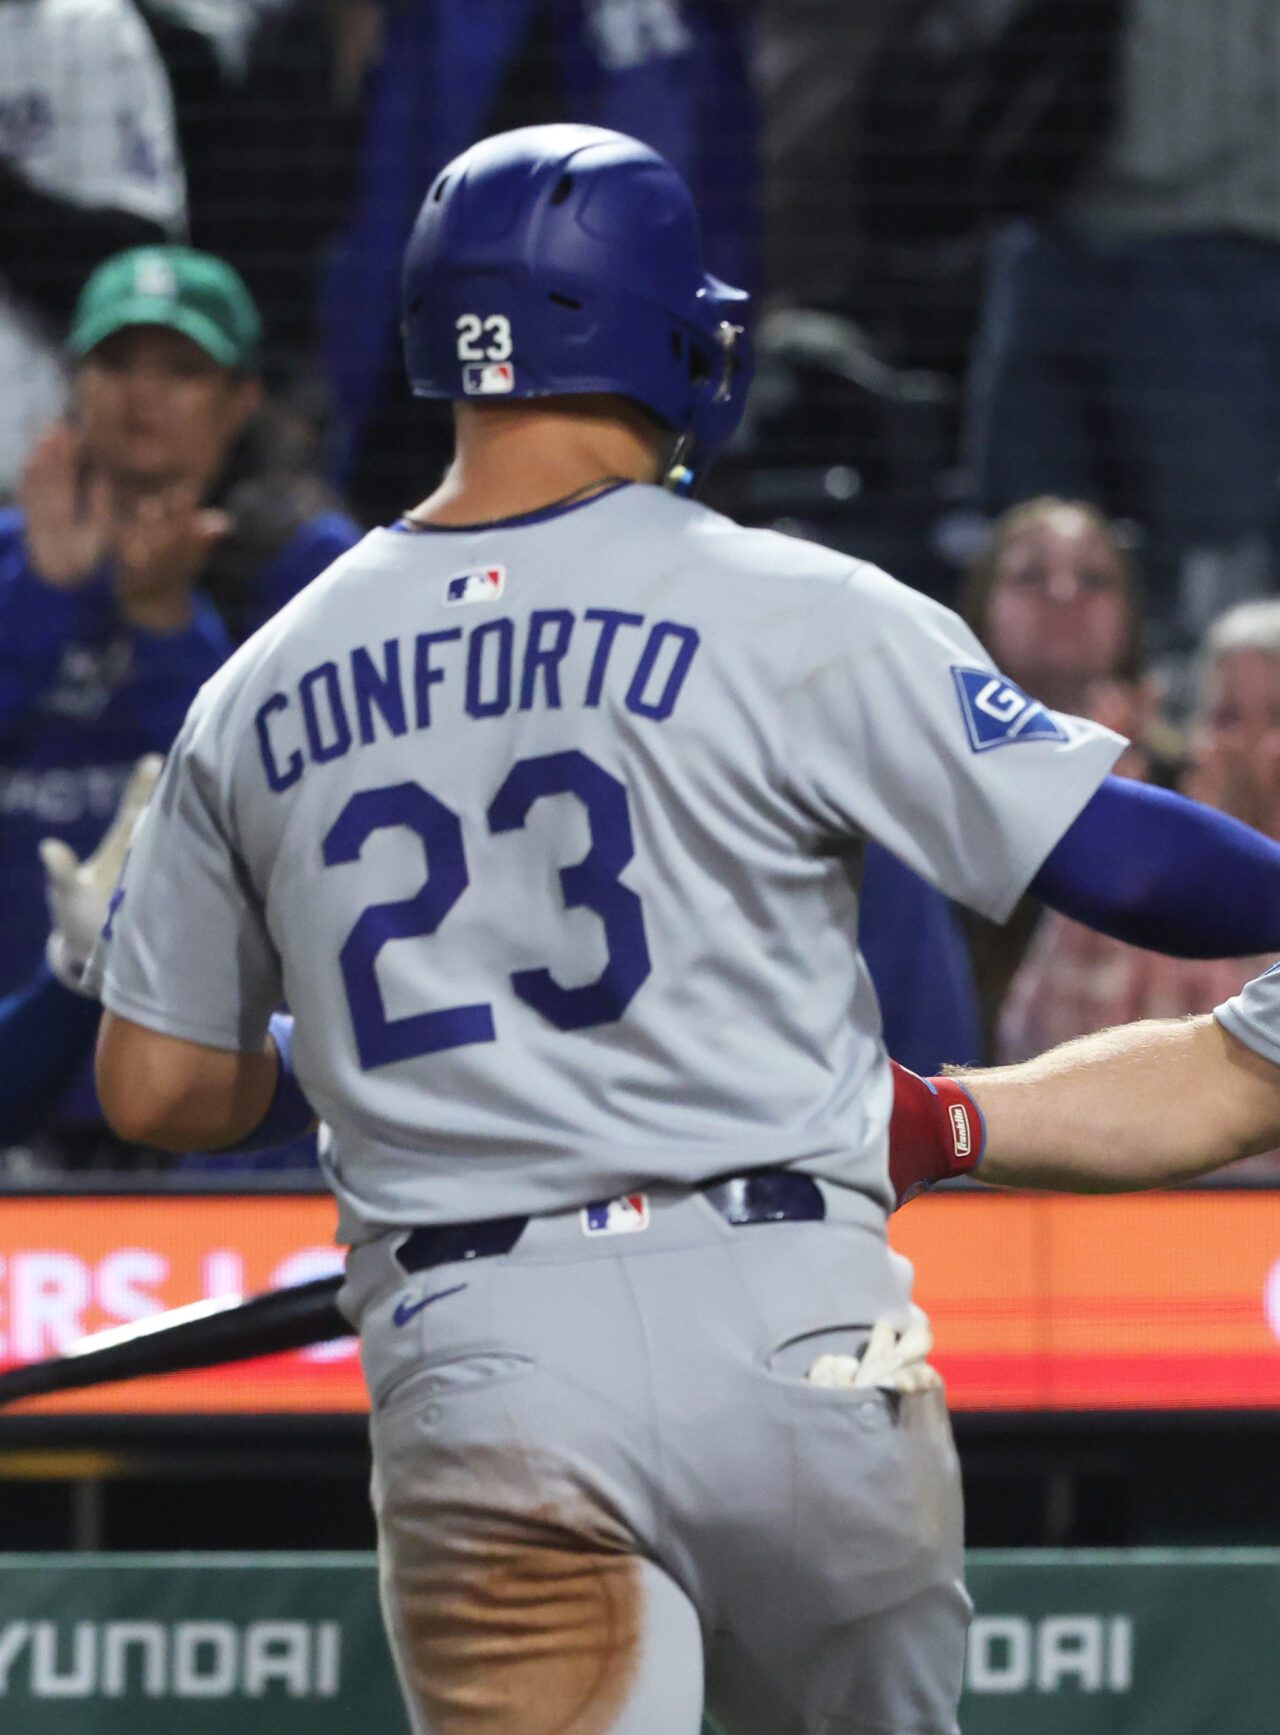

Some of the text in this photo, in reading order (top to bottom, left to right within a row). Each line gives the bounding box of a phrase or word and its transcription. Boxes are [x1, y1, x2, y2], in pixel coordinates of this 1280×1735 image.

[456, 313, 513, 361] 23
[254, 607, 701, 794] CONFORTO
[321, 749, 652, 1072] 23
[0, 1245, 172, 1362] RS
